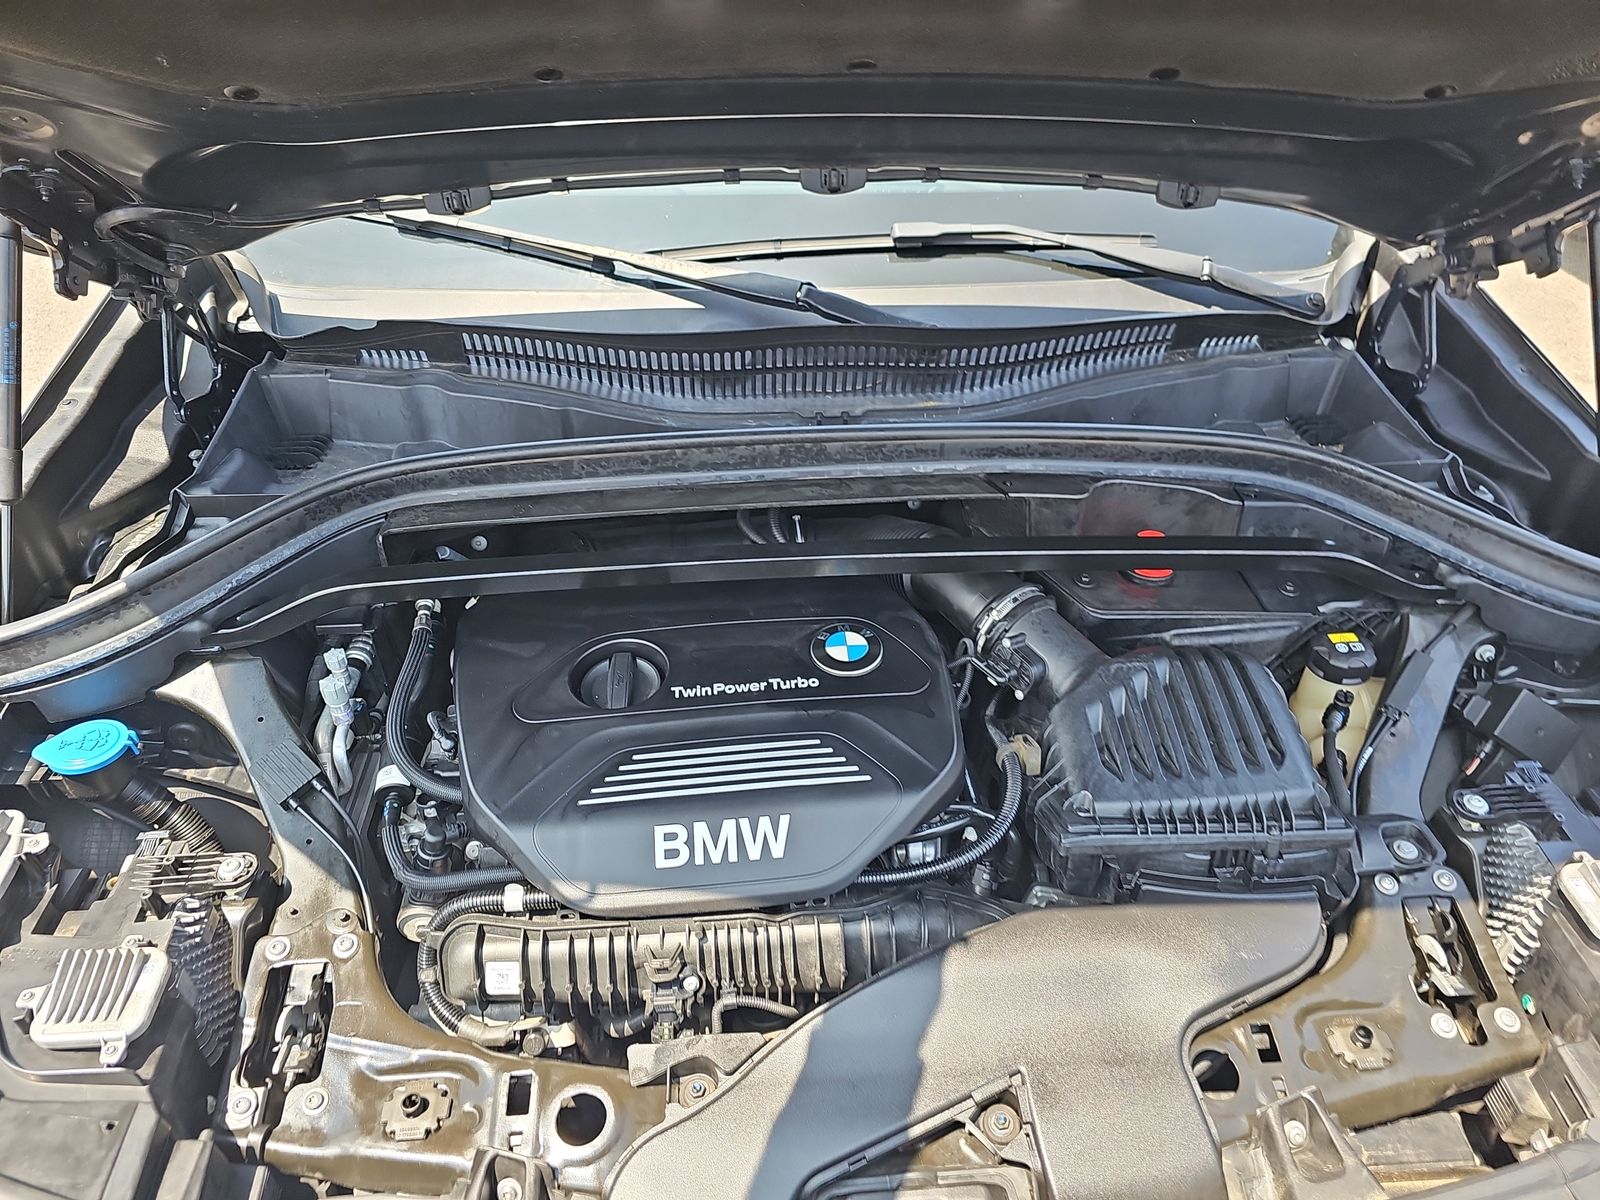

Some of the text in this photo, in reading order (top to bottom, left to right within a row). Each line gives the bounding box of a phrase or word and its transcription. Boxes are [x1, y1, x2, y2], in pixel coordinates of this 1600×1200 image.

[816, 624, 873, 640] BMW
[768, 676, 820, 691] Turbo
[653, 813, 791, 870] BMW
